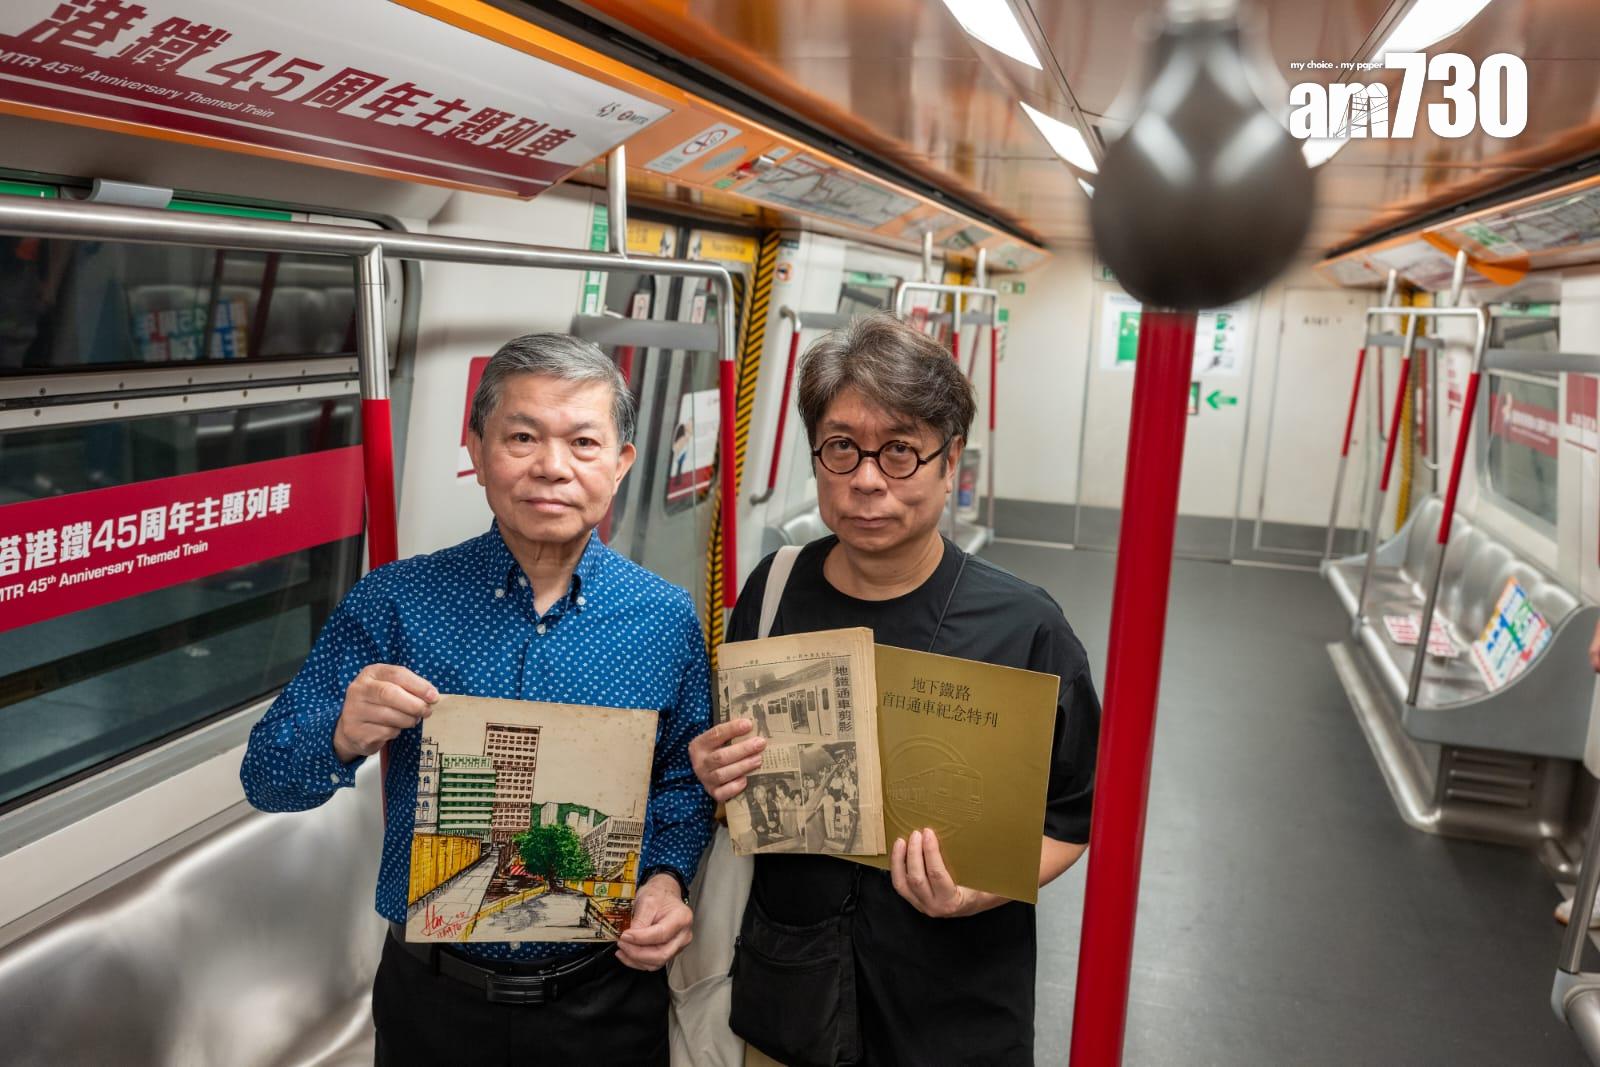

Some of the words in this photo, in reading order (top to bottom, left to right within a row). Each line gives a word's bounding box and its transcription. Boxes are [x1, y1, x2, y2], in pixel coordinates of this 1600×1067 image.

[41, 61, 85, 74] 45th
[80, 70, 184, 99] Anniversary
[184, 91, 242, 111] Themed
[240, 104, 275, 119] Train
[27, 575, 57, 593] 45th
[58, 559, 135, 588] Anniversary
[136, 546, 181, 568] Themed
[182, 540, 209, 557] Train
[882, 691, 1000, 728] 首日通車紀念特刊
[911, 676, 971, 702] 地下鐵路
